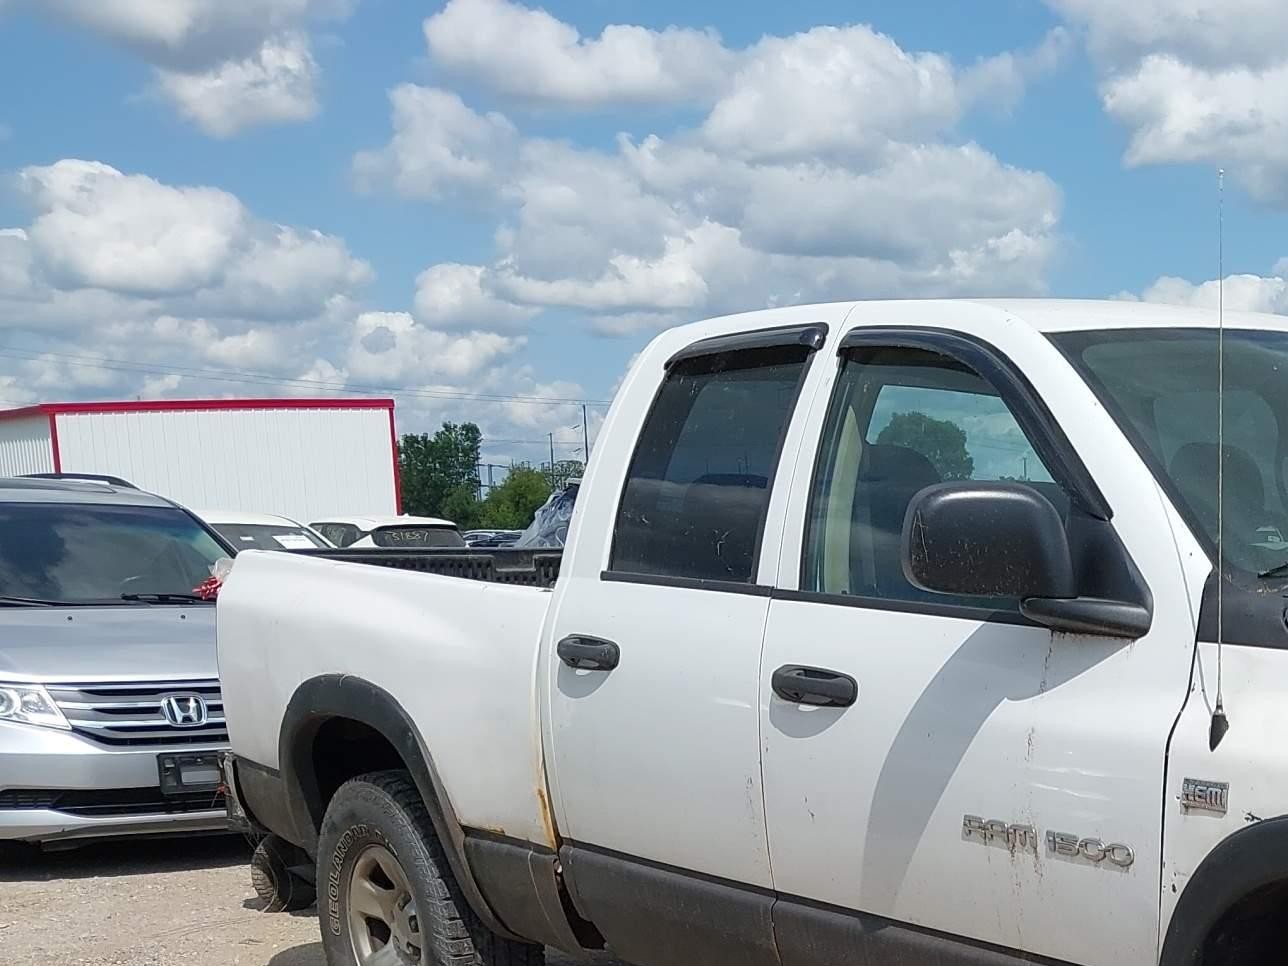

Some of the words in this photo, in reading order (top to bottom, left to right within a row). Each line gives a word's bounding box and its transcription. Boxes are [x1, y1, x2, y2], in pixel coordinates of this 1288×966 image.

[1182, 782, 1229, 808] HEMI
[962, 814, 1038, 850] RAM
[1046, 830, 1135, 867] 1500
